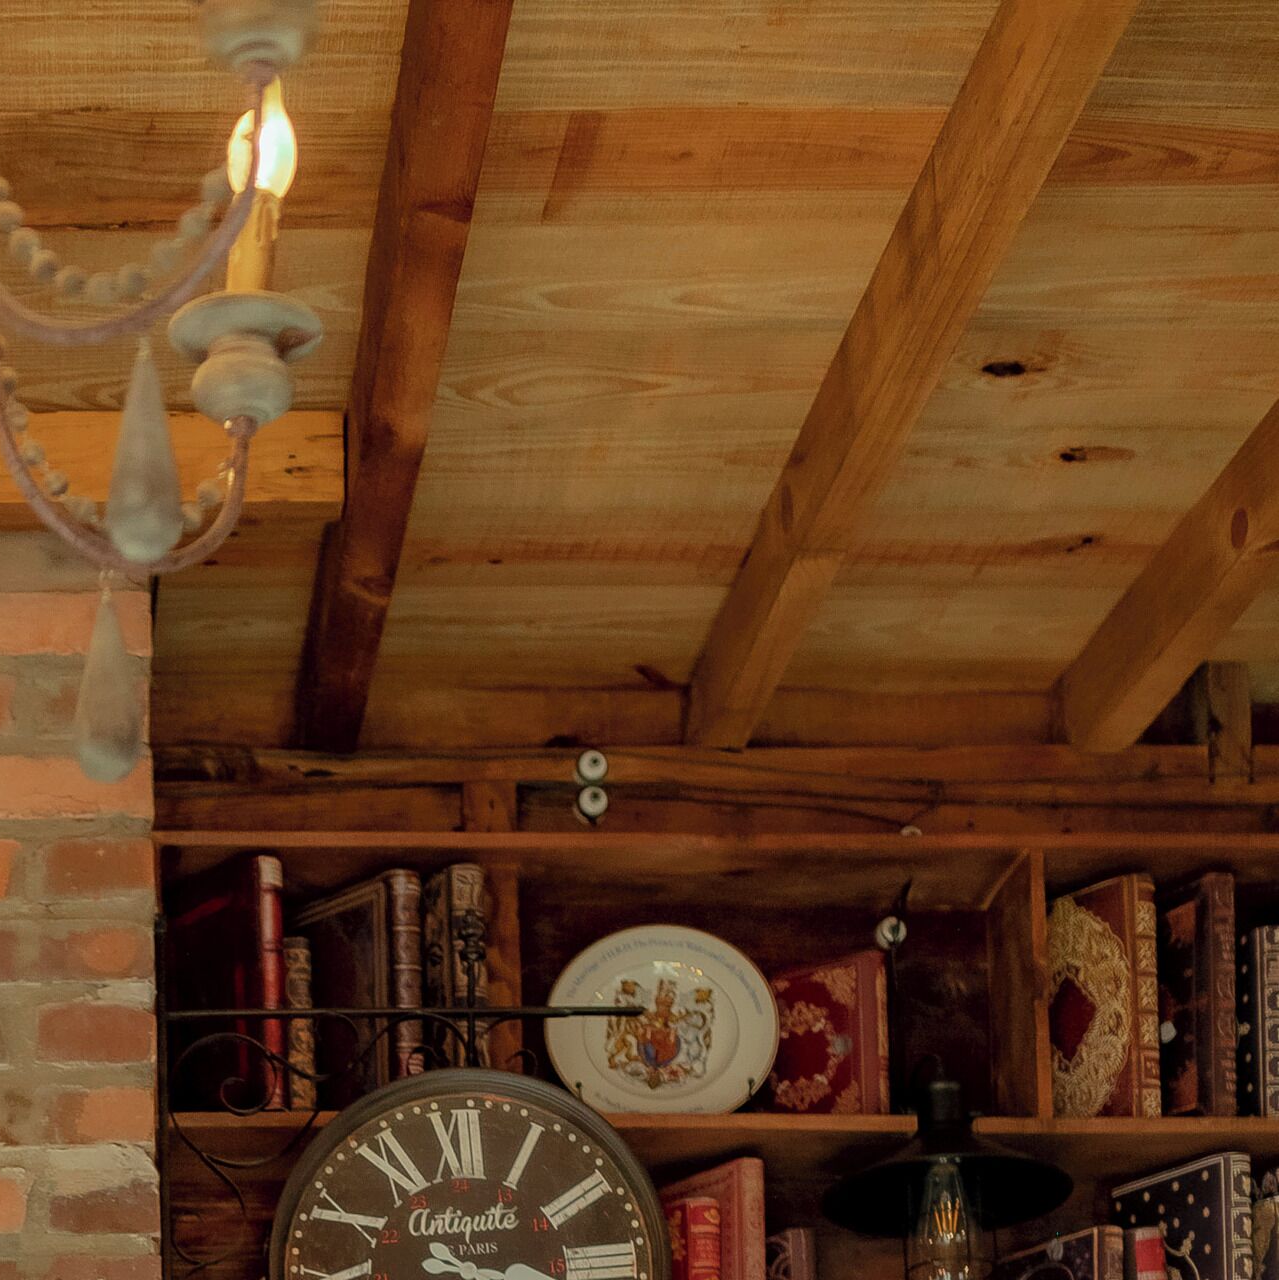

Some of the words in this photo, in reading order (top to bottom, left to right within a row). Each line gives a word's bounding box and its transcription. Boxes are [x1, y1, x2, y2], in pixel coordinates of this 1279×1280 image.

[426, 1109, 486, 1184] XII
[503, 1122, 546, 1190] I
[355, 1127, 431, 1208] XI
[410, 1195, 427, 1210] 23
[497, 1188, 513, 1202] 13
[540, 1169, 613, 1230] II
[309, 1187, 389, 1249] X
[533, 1216, 549, 1232] 14
[381, 1229, 399, 1244] 22
[458, 1241, 499, 1256] PARIS
[549, 1258, 566, 1275] 15
